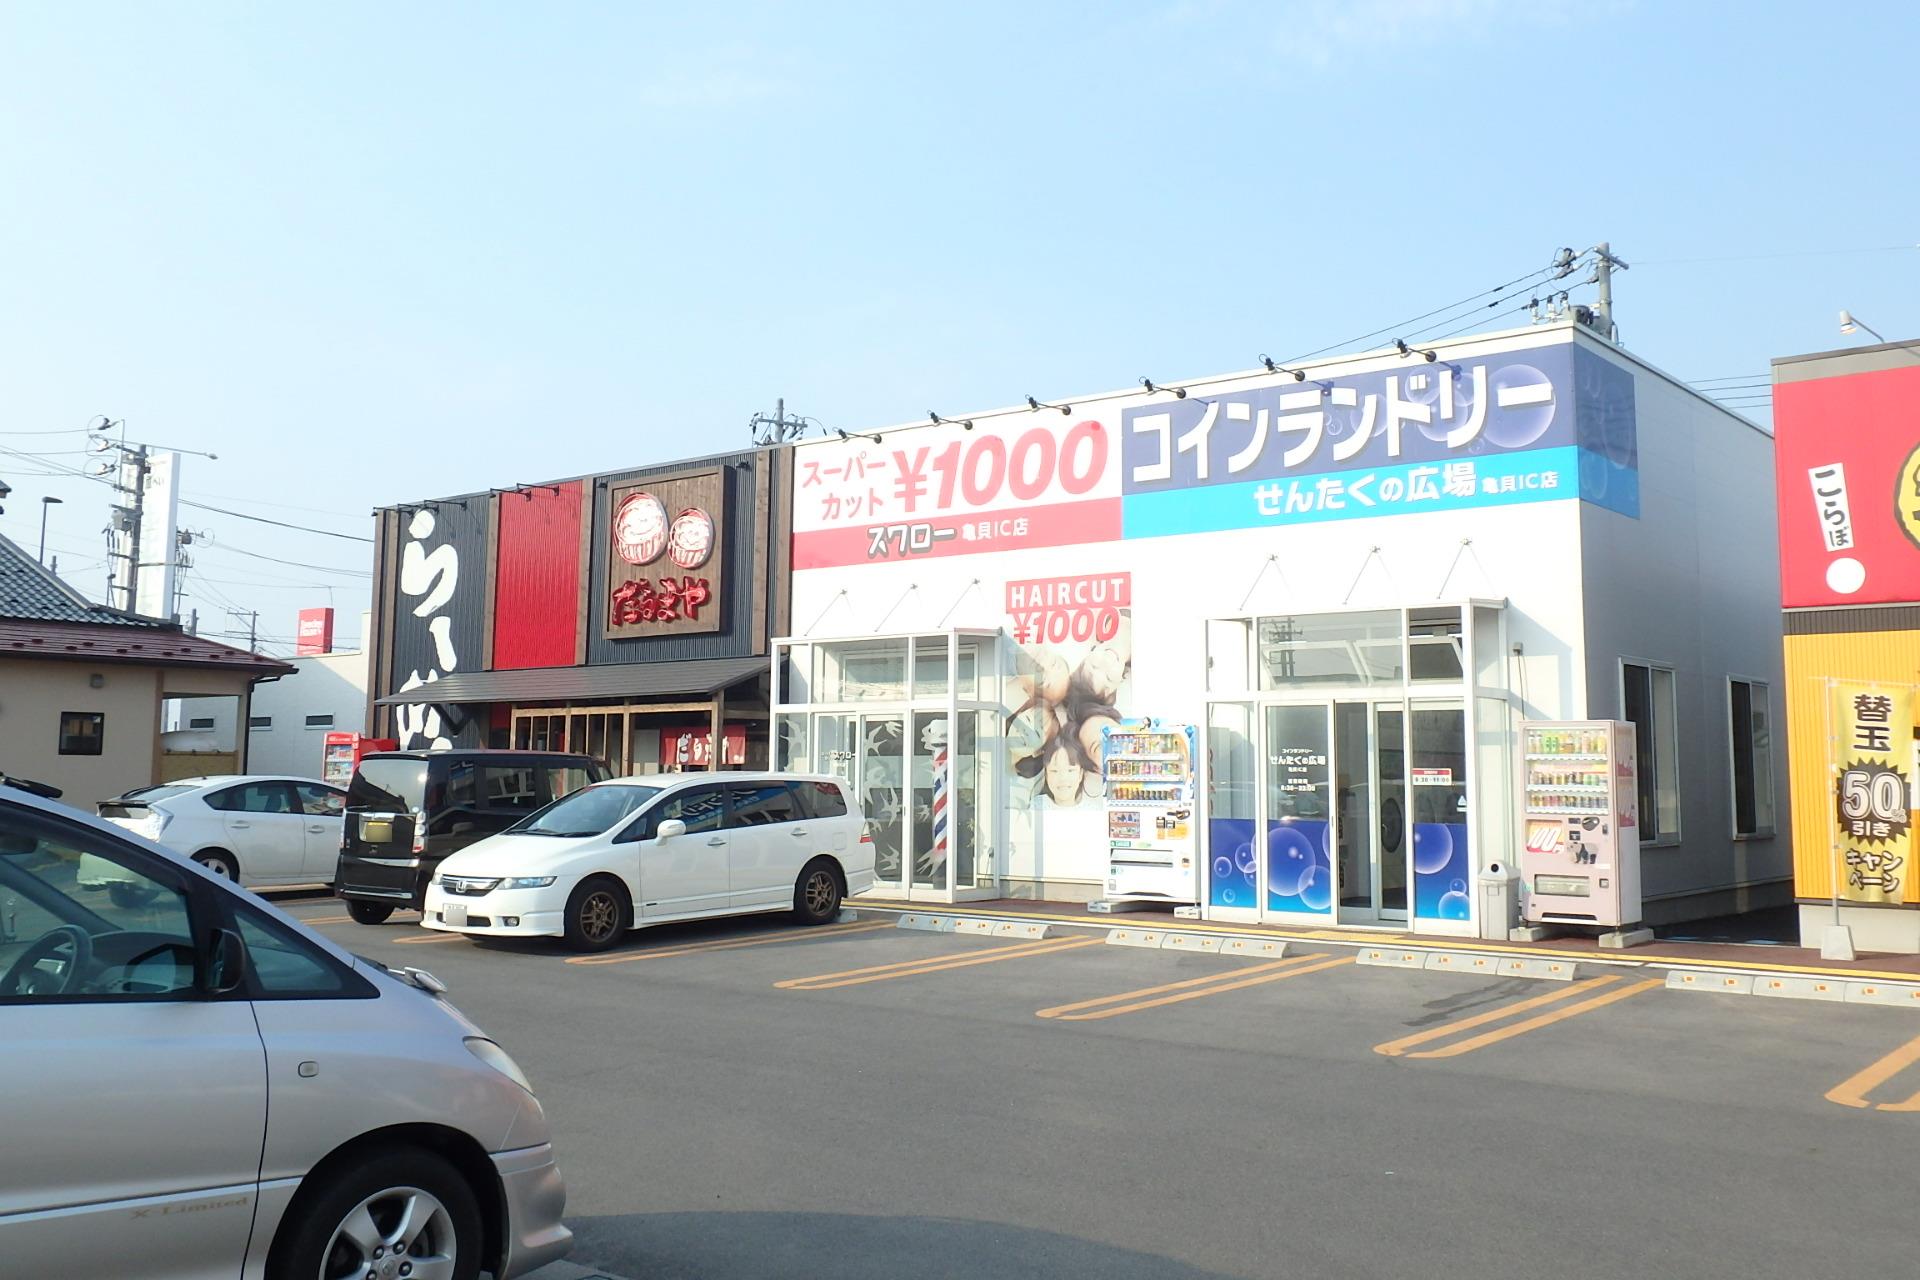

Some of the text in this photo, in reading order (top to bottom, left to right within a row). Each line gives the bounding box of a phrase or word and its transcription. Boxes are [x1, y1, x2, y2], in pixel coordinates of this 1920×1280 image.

[1133, 365, 1553, 483] コインランドリー
[802, 452, 886, 488] スーパー
[892, 420, 1109, 513] ¥1000
[821, 488, 884, 520] カット
[1254, 461, 1478, 516] せんたくの広場
[867, 523, 958, 558] スワロー
[1011, 578, 1125, 608] HAIRCUT
[1013, 606, 1119, 645] ¥1000
[1854, 694, 1891, 751] 替玉
[1852, 821, 1891, 837] 引き
[1846, 849, 1903, 872] キャン
[1849, 870, 1899, 893] ペーン
